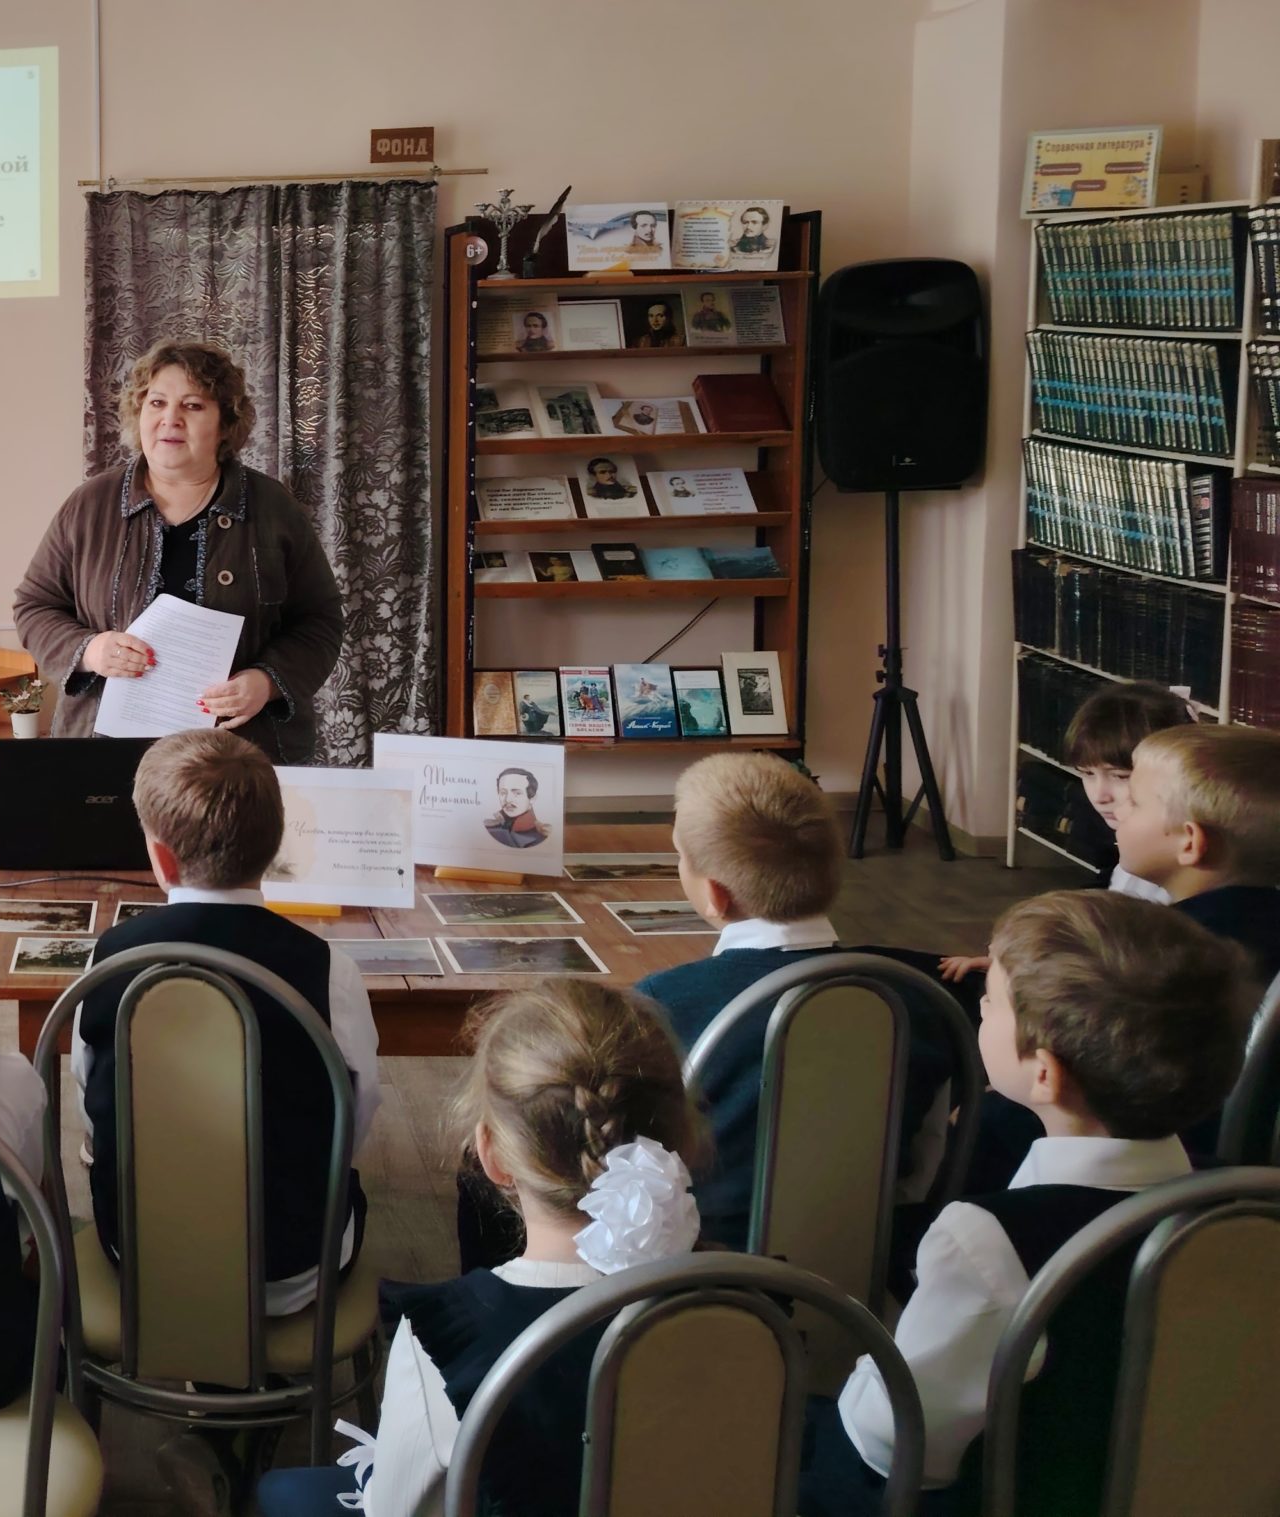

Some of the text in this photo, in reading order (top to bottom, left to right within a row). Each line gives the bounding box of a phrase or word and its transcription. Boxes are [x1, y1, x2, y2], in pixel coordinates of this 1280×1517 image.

[377, 138, 428, 155] ФОНД
[1045, 140, 1144, 153] Справочная литература
[466, 244, 482, 258] 6+
[424, 764, 478, 786] Михаил
[85, 796, 118, 804] acer
[419, 785, 481, 808] Лермонтов
